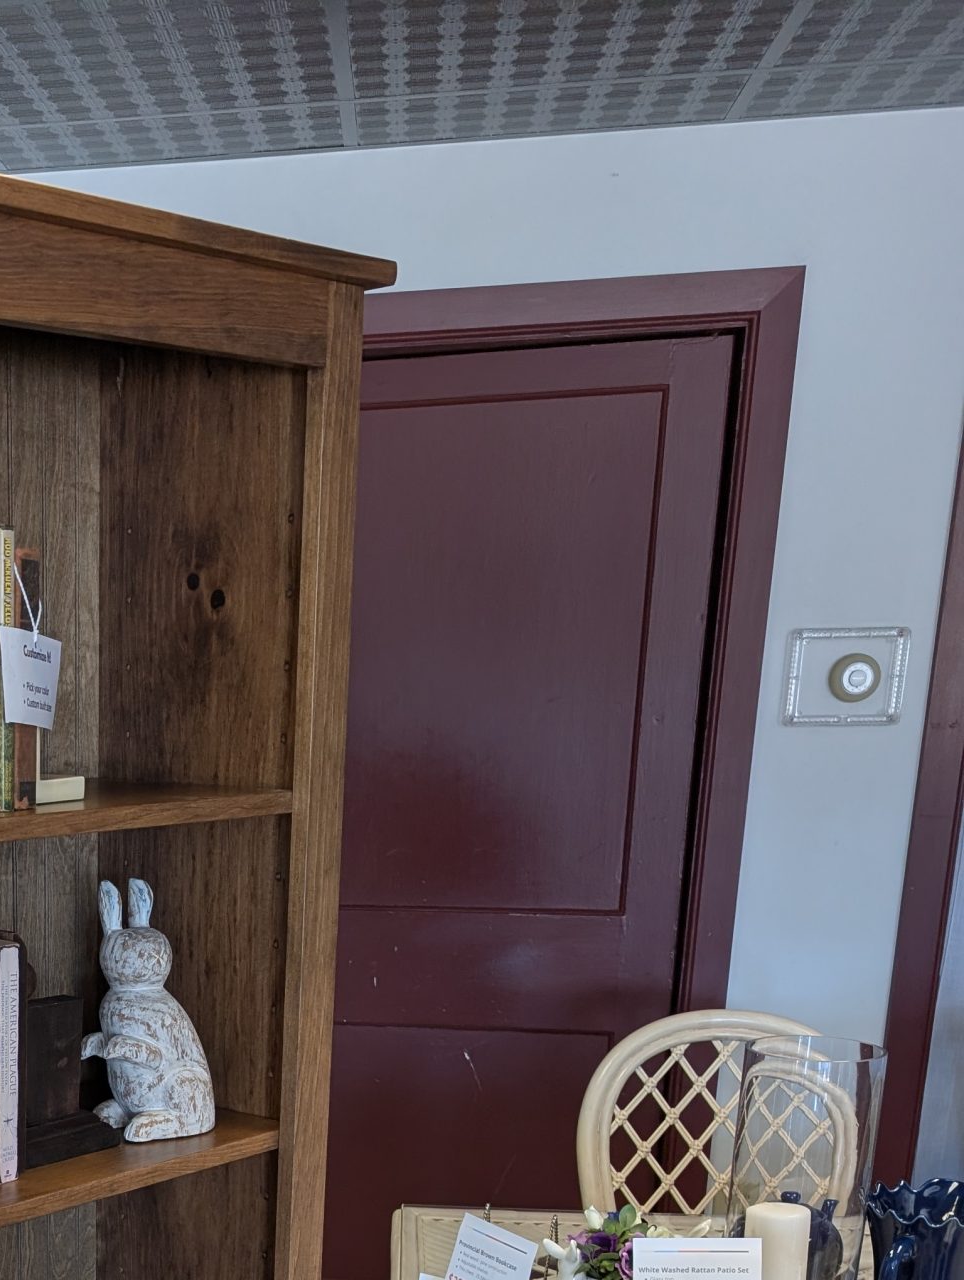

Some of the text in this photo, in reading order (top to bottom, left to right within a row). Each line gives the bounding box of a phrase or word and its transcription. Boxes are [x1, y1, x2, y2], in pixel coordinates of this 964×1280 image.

[3, 600, 12, 626] FIELD
[9, 971, 18, 1097] THE AMERICAN PLAGUE
[638, 1266, 750, 1274] White Washed Rattan Patio Set
